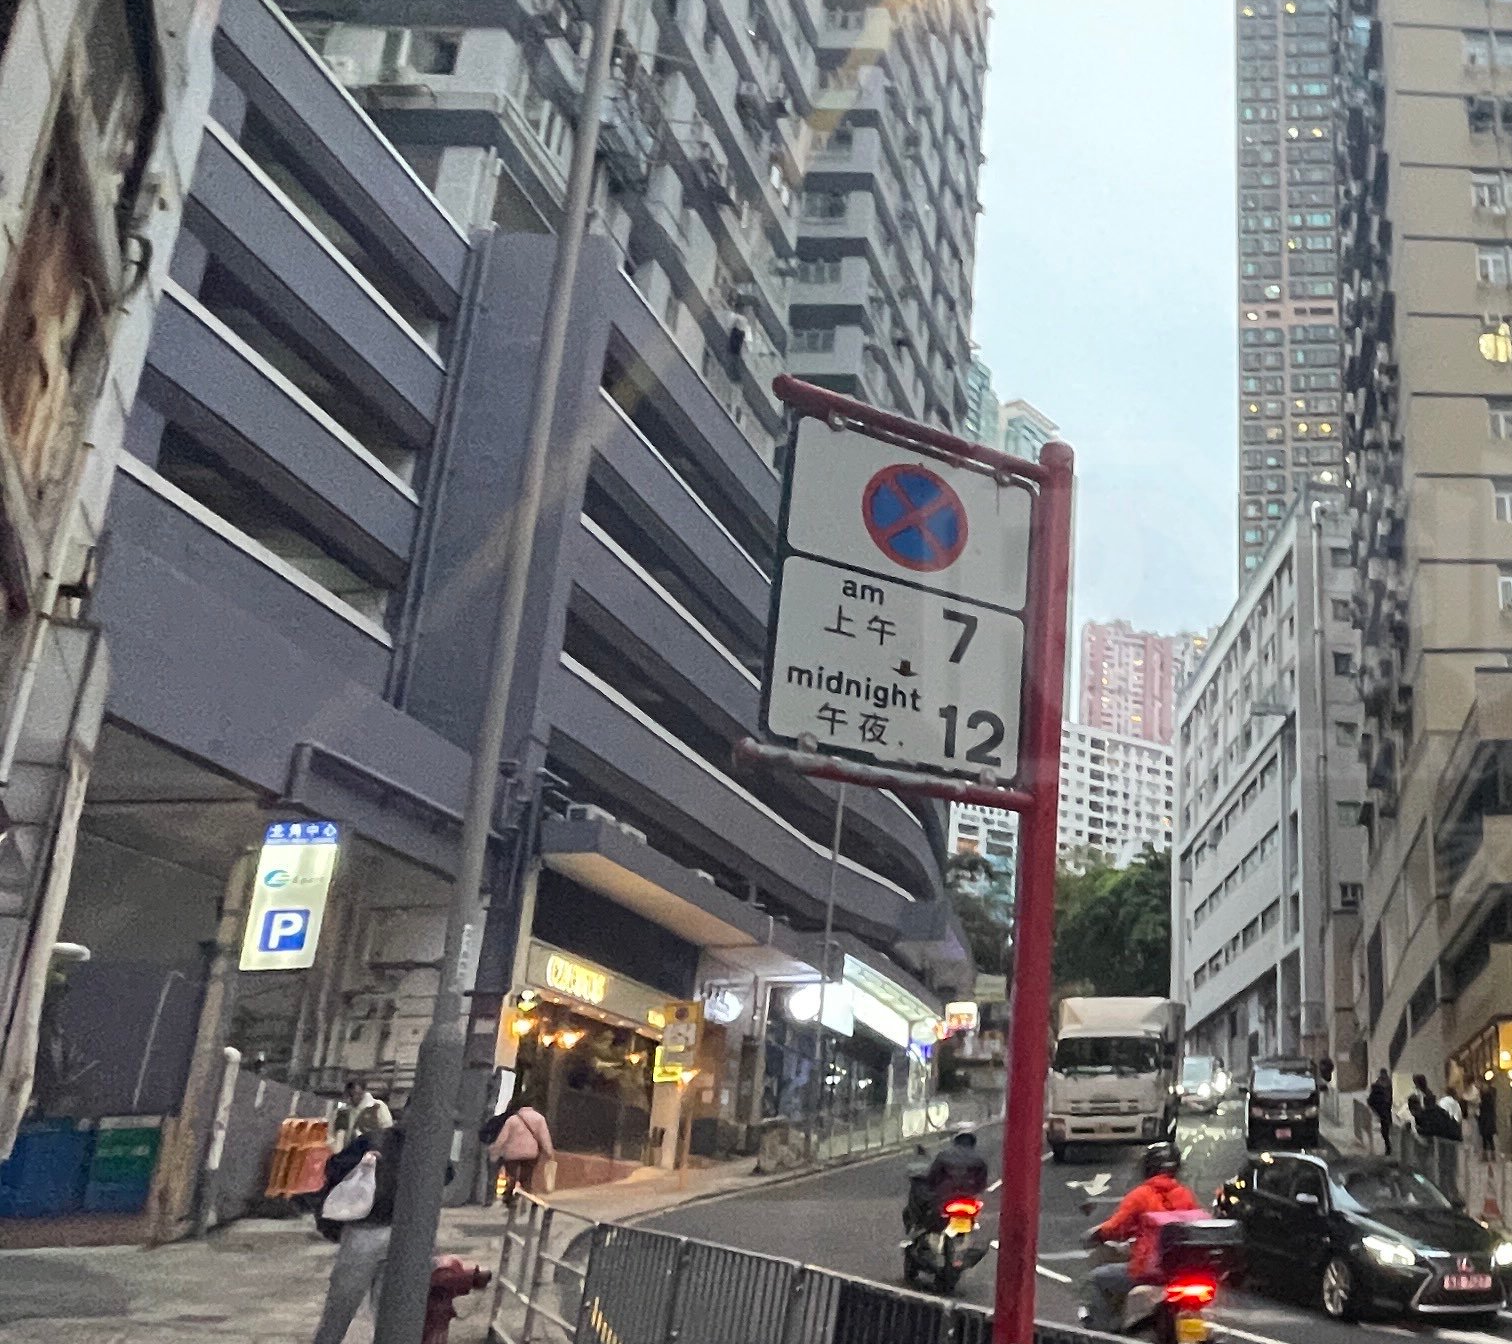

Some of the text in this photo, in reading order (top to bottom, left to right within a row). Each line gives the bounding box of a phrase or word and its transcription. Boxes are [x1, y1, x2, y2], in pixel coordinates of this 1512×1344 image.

[841, 579, 885, 606] am
[824, 605, 979, 664] 上午 7
[786, 663, 922, 712] midnight
[816, 702, 1006, 766] 午夜 12
[267, 912, 304, 949] P
